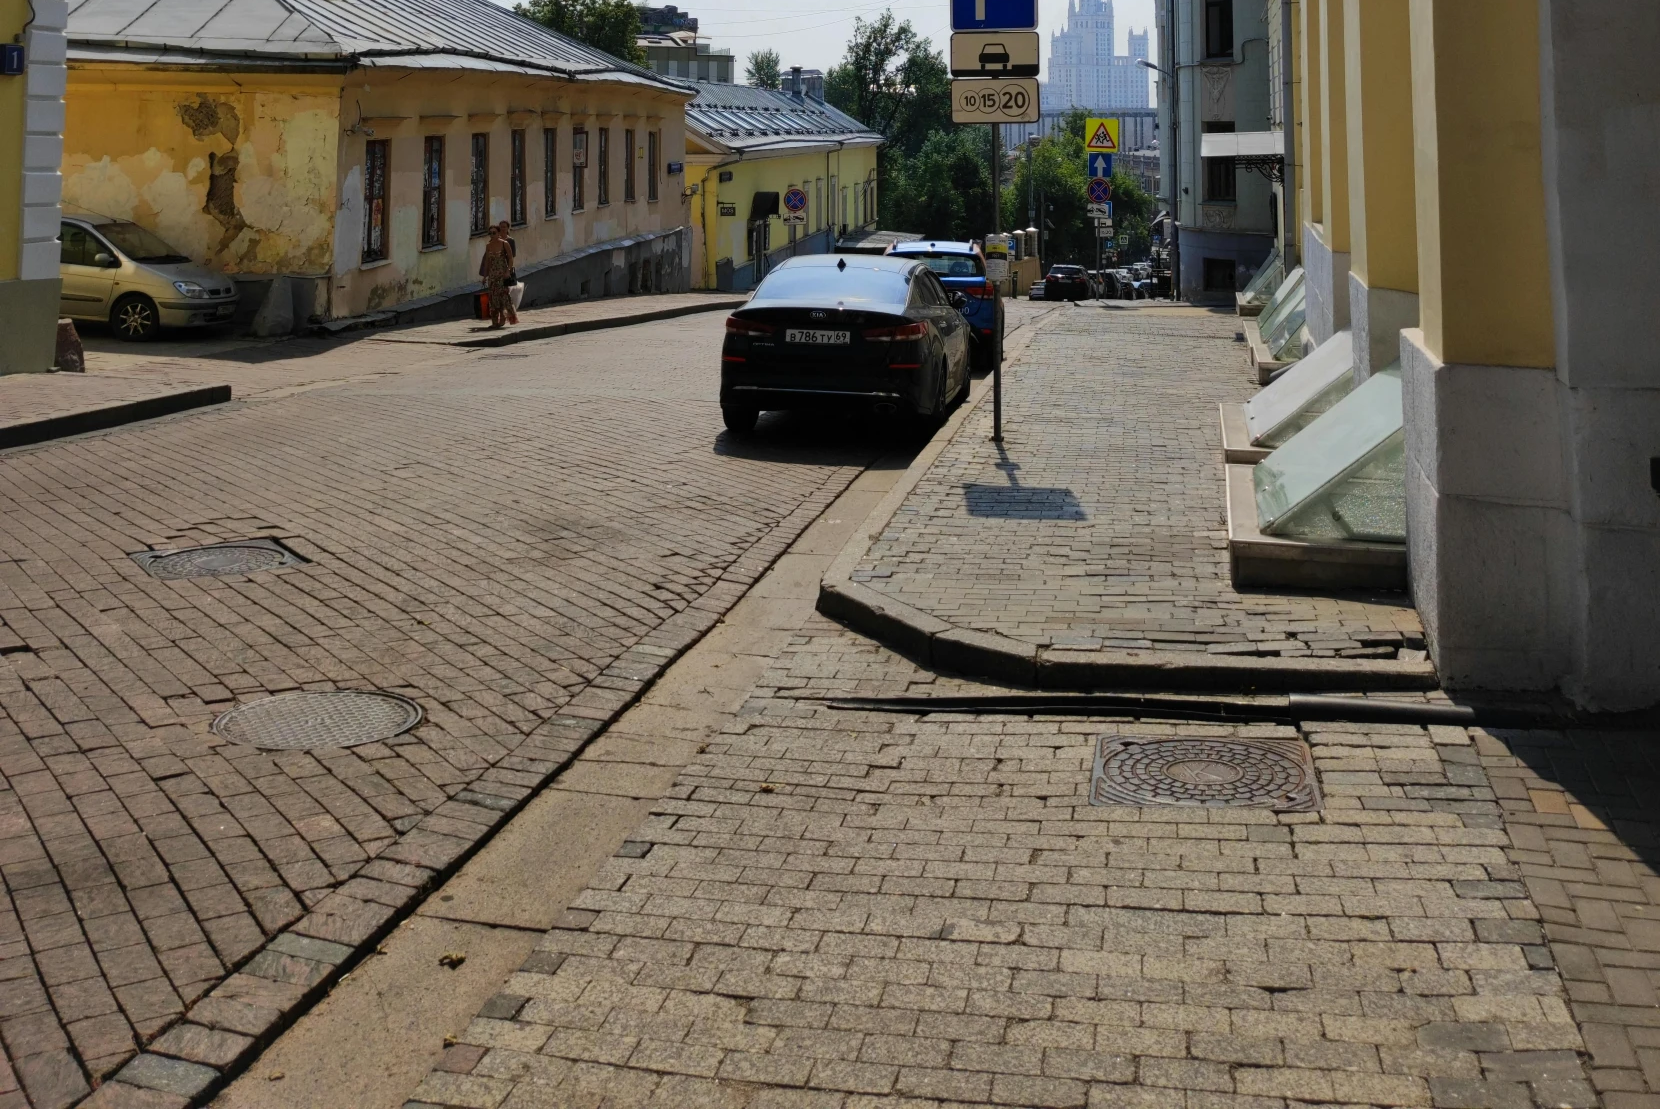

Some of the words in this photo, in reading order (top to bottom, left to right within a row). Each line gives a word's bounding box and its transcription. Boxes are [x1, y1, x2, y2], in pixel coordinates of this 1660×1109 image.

[964, 95, 976, 107] 10
[980, 93, 996, 108] 15
[1002, 91, 1026, 109] 20
[836, 332, 847, 341] 69
